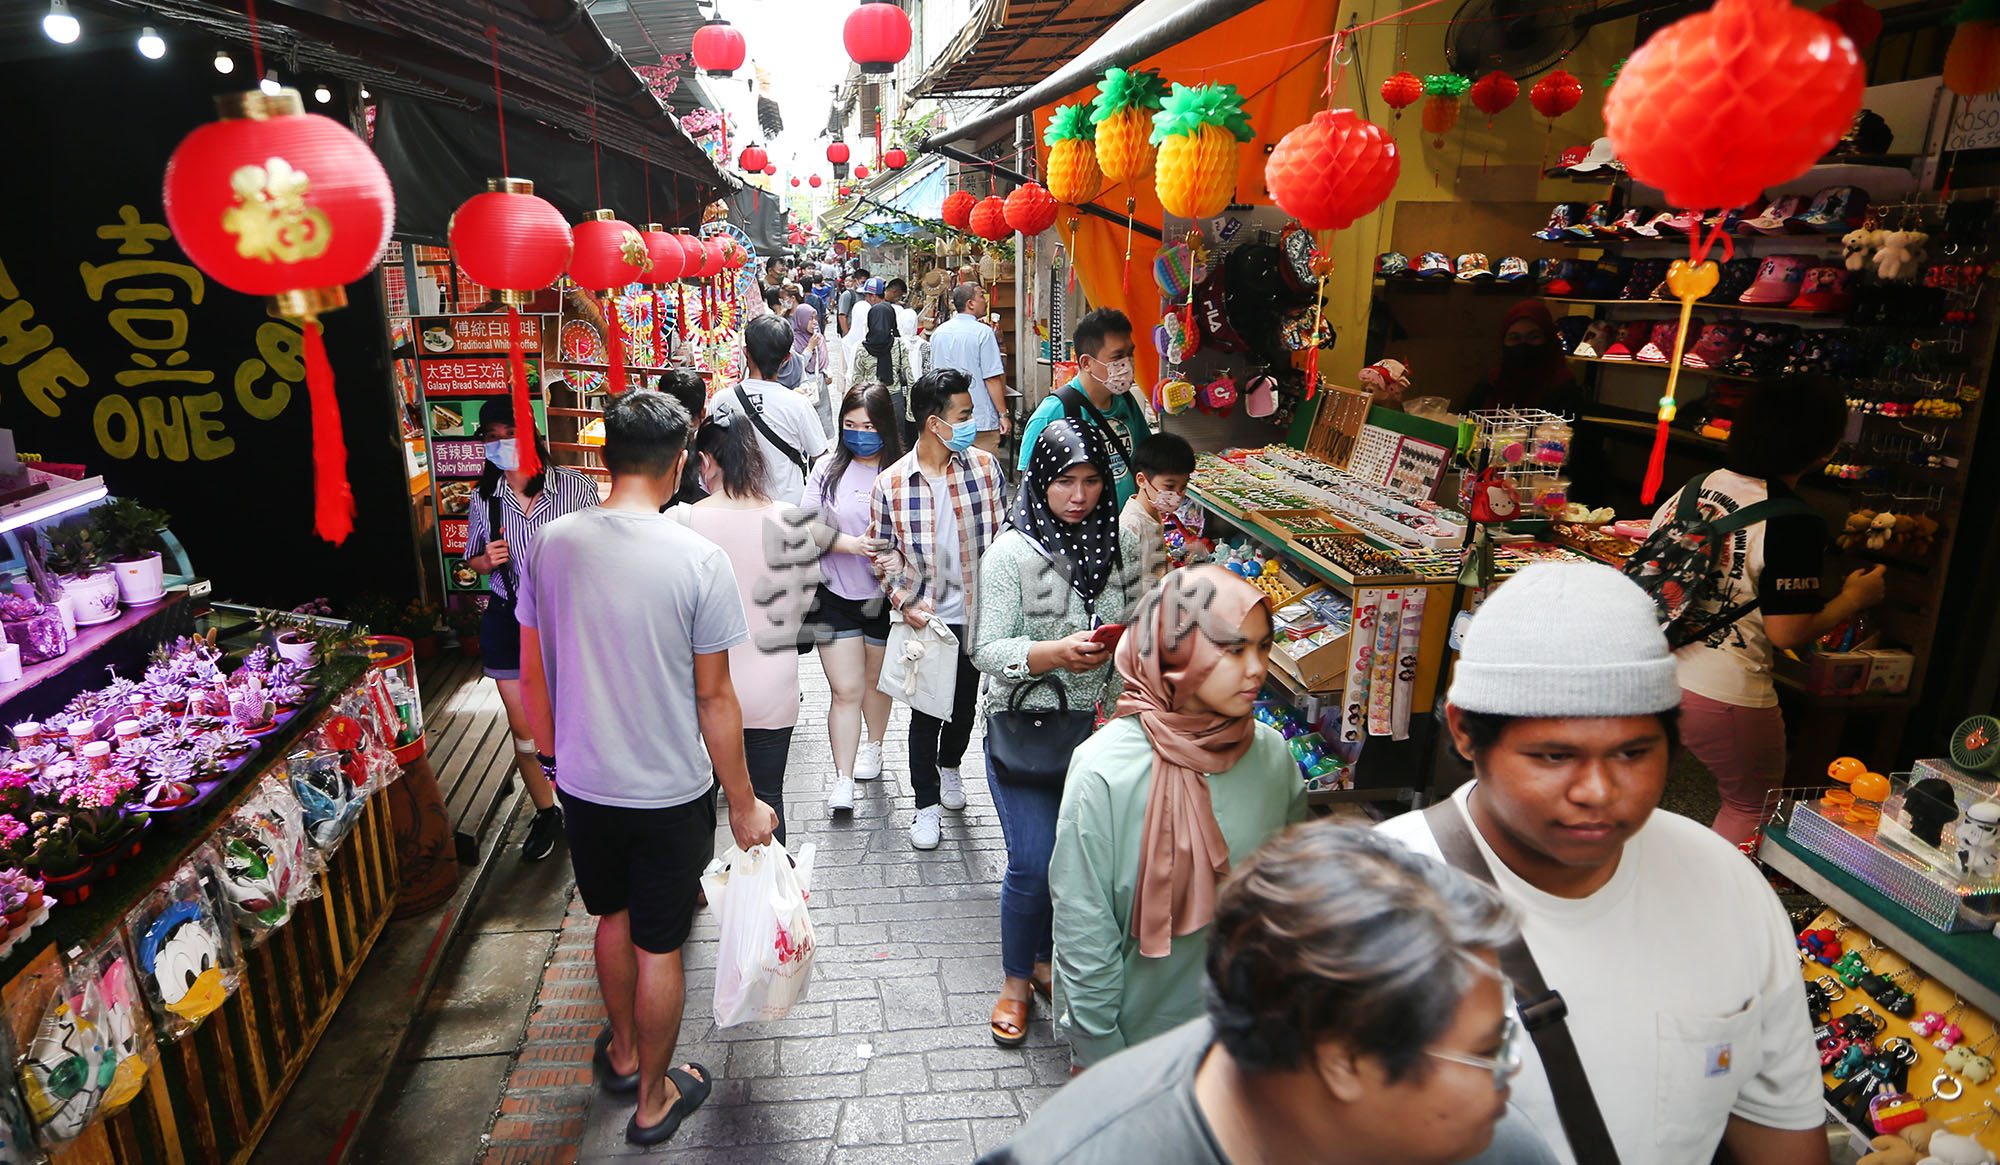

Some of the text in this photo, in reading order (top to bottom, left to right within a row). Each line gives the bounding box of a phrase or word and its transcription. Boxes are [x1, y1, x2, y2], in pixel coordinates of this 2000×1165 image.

[1203, 300, 1222, 332] FILA
[456, 339, 493, 350] Traditional
[518, 339, 538, 350] offee
[426, 362, 505, 379] 太空包三文治
[427, 379, 507, 392] Galaxy Bread Sandwich
[93, 392, 236, 461] ONE
[436, 462, 456, 474] Spicy
[457, 461, 482, 474] Shrimp
[1734, 529, 1747, 551] OWN
